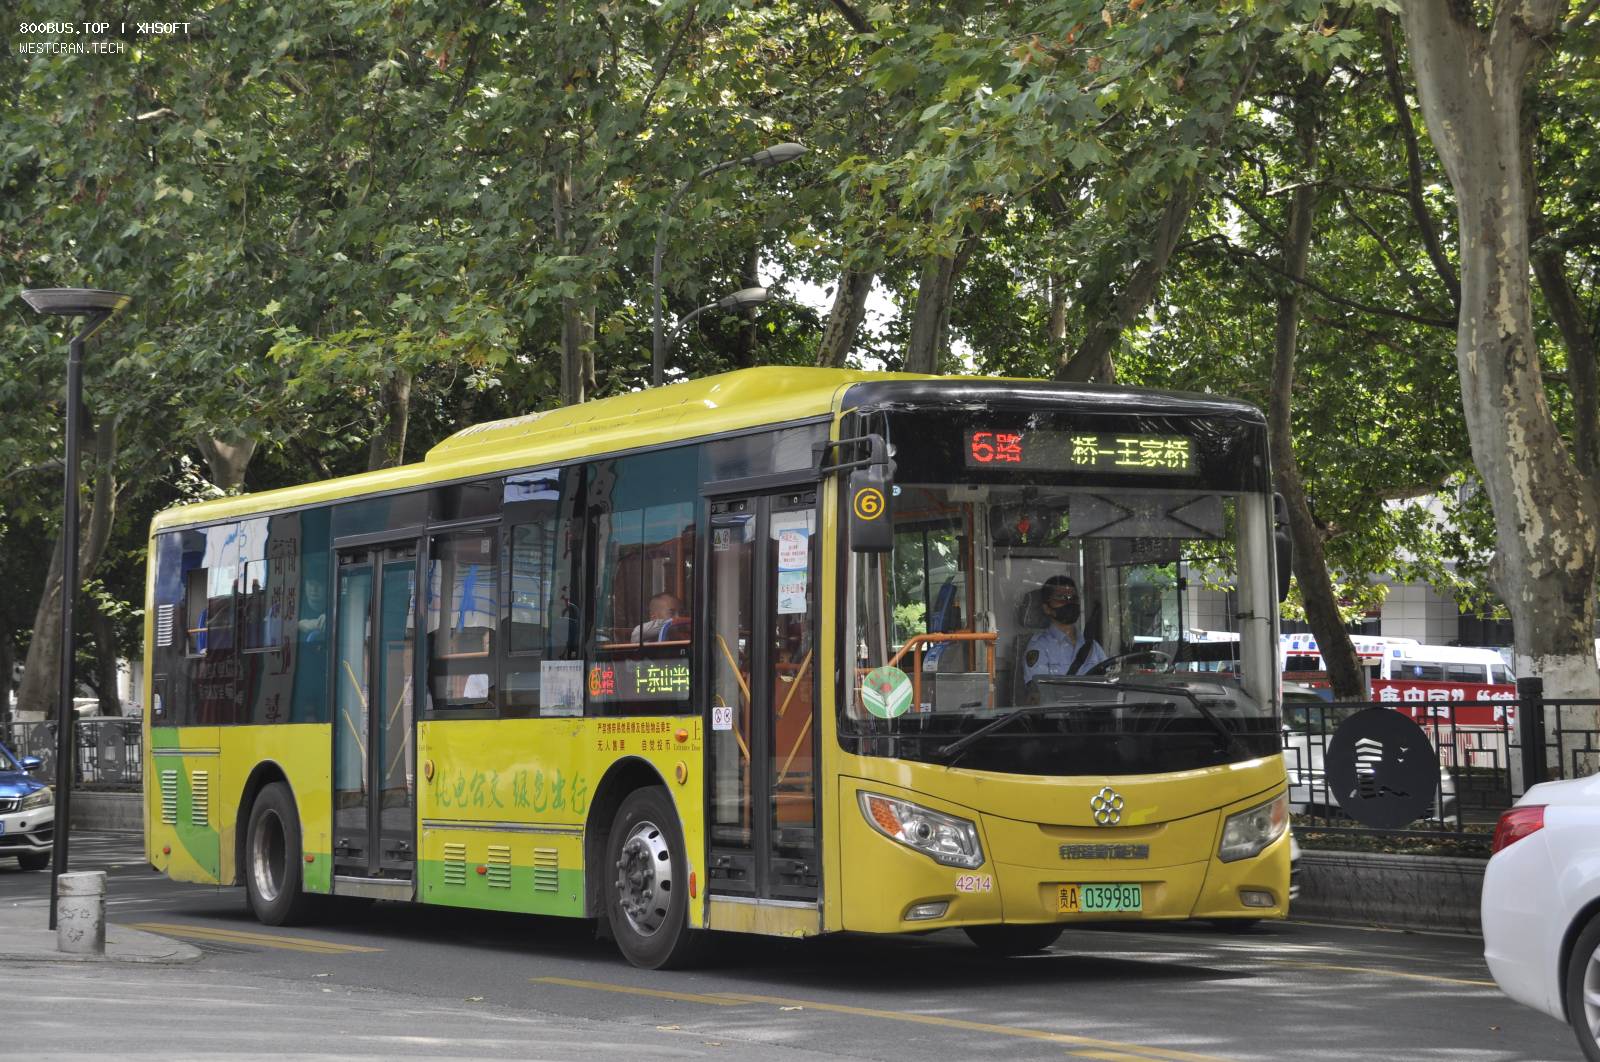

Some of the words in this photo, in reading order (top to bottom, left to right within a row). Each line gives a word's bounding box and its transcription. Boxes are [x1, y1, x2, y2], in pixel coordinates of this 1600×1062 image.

[972, 432, 1021, 462] 6路
[861, 494, 878, 513] 6
[597, 739, 625, 752] 无人售票
[641, 739, 671, 752] 自觉投币
[434, 768, 504, 809] 纯电公交
[513, 768, 588, 816] 绿色出行
[956, 875, 992, 891] 4214
[1060, 888, 1078, 909] 贵A
[1085, 887, 1141, 909] 03998D
